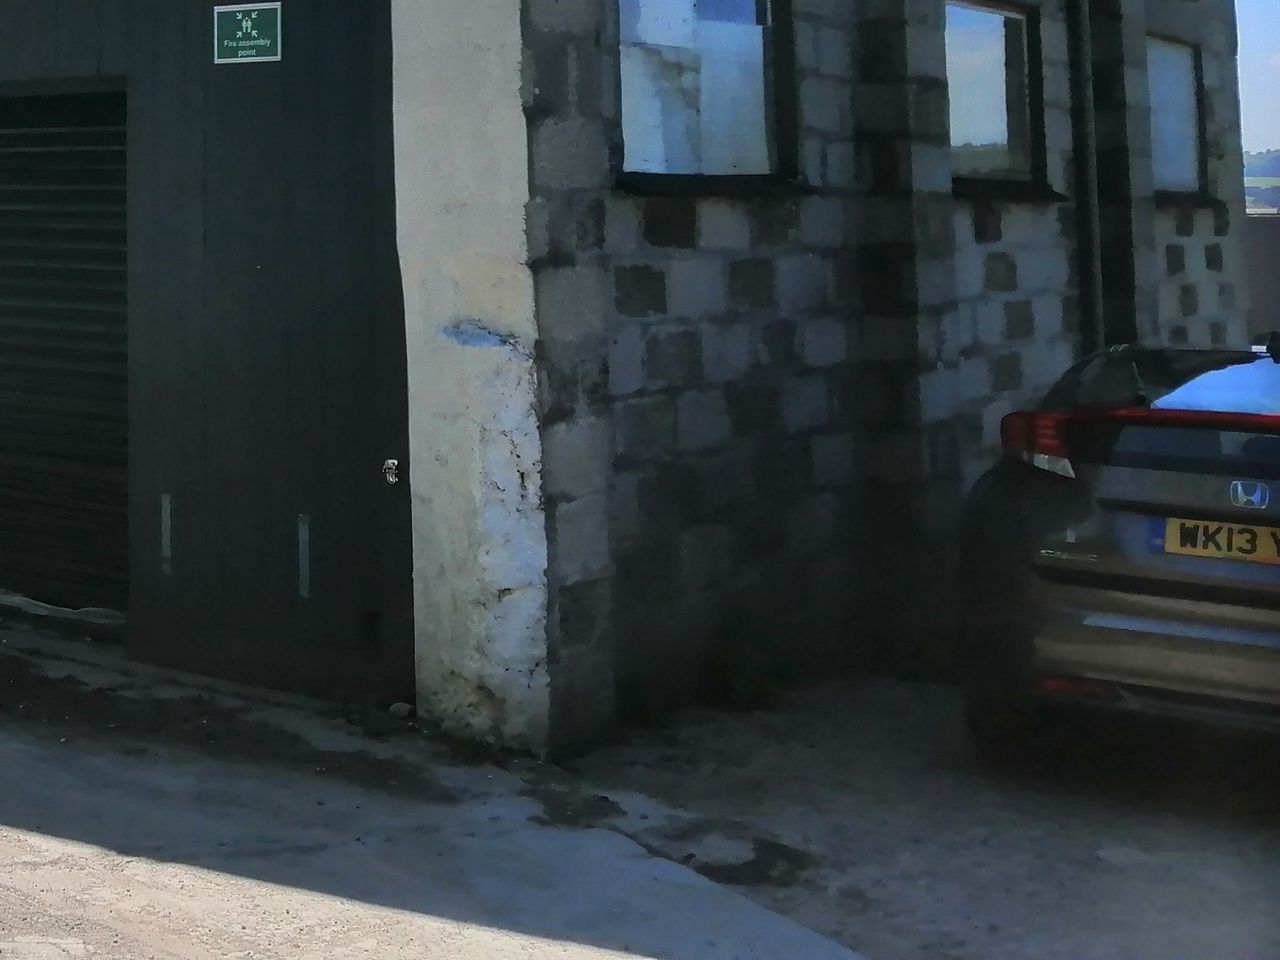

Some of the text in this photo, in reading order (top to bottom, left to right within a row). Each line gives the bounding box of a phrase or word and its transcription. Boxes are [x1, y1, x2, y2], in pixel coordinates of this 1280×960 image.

[238, 38, 271, 47] assembly
[238, 49, 256, 57] point
[1180, 523, 1258, 555] WK13
